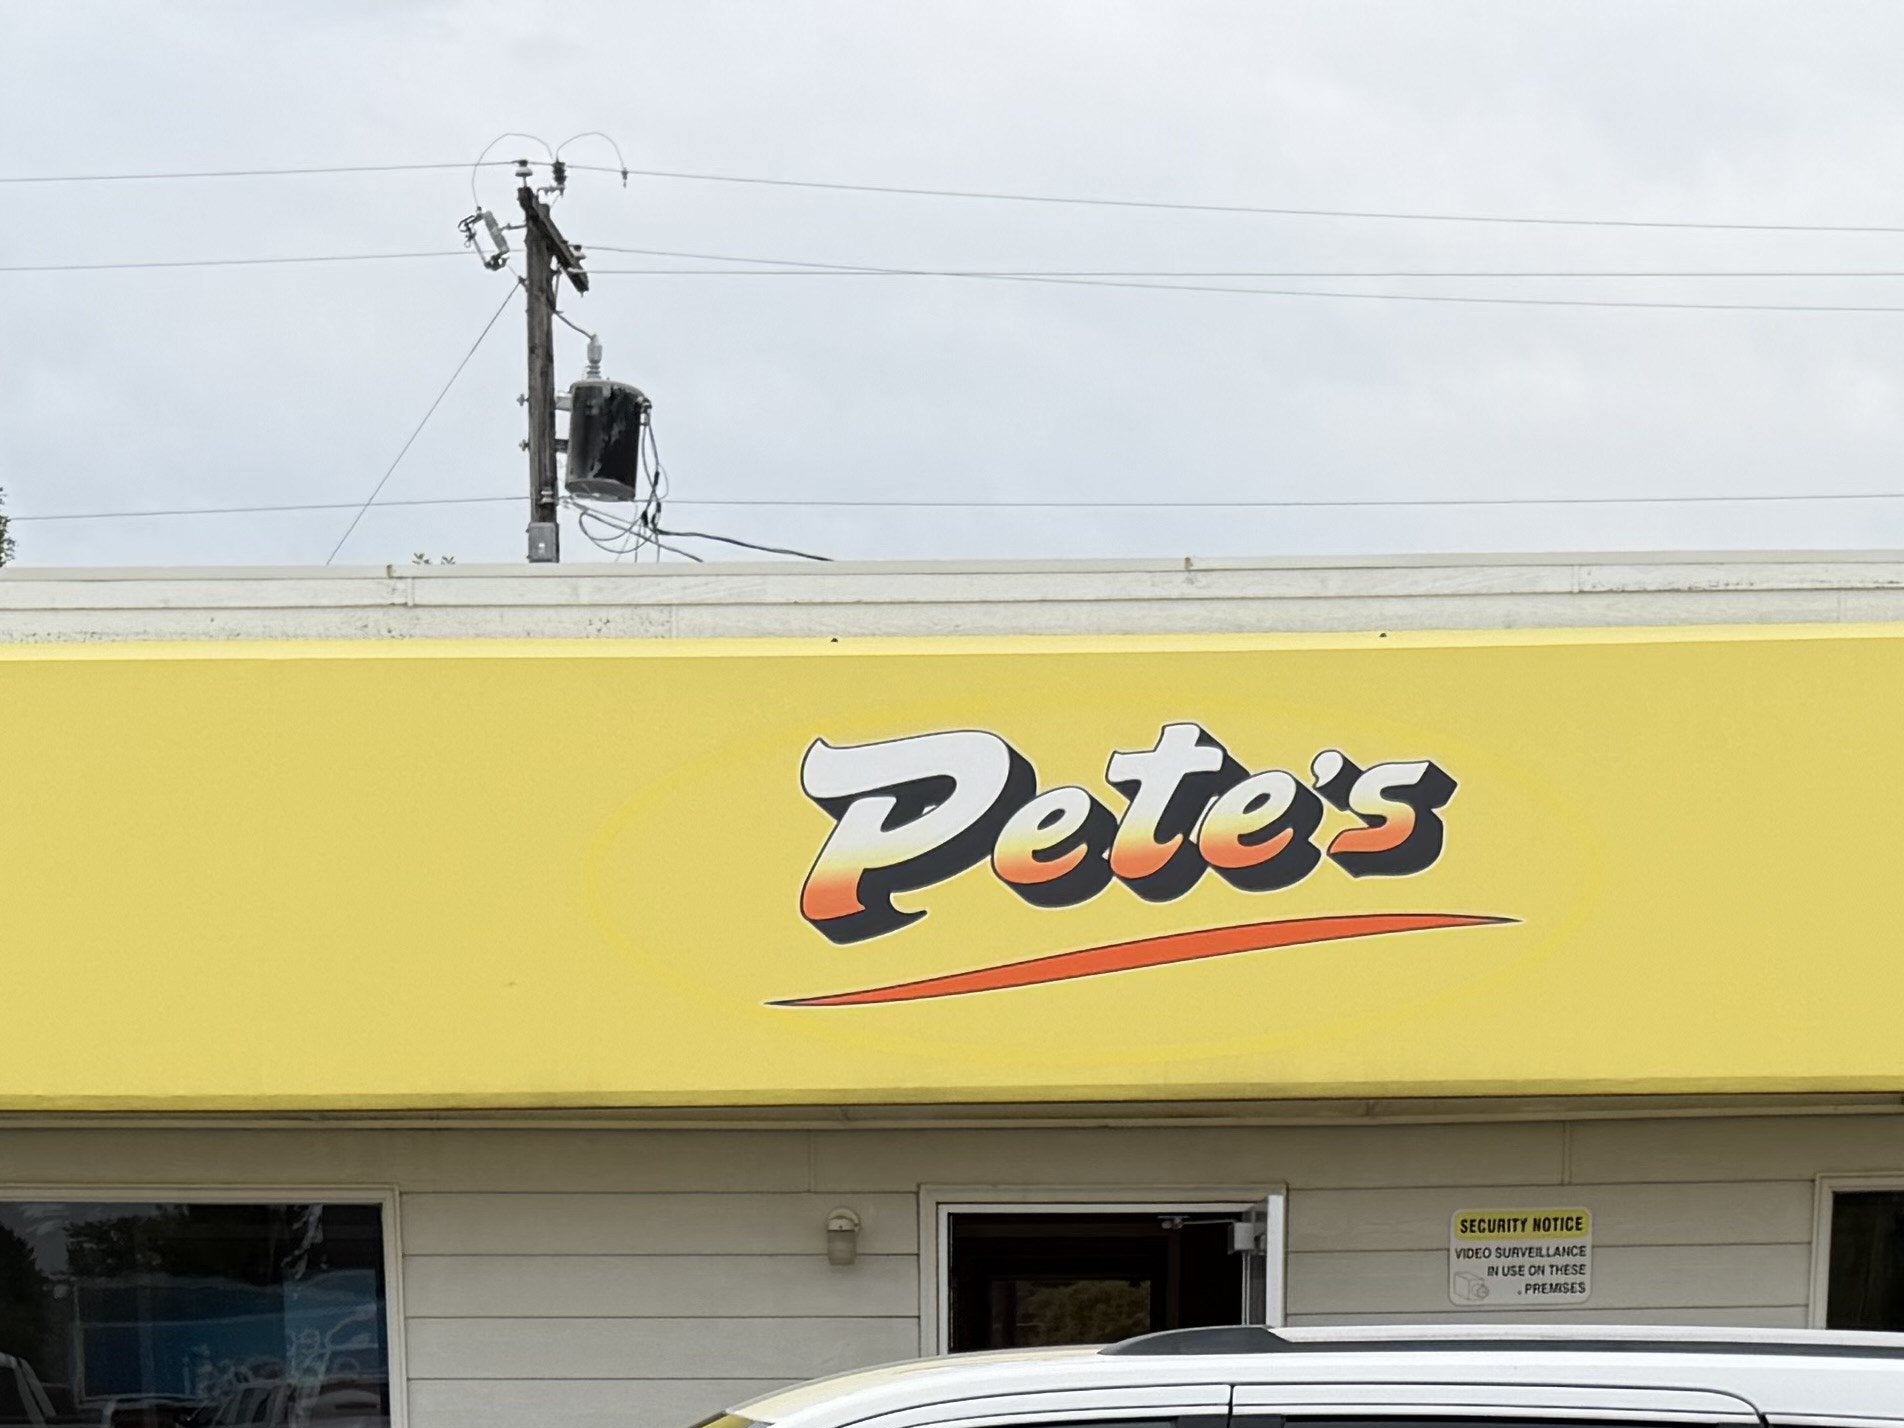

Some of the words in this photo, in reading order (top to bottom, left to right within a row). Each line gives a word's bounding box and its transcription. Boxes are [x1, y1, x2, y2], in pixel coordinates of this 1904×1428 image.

[799, 723, 1458, 944] Pete's
[1459, 1217, 1528, 1235] SECURITY
[1532, 1215, 1584, 1232] NOTICE
[1455, 1247, 1492, 1260] VIDEO
[1494, 1245, 1587, 1259] SURVEILLANCE
[1487, 1265, 1499, 1277] IN
[1502, 1264, 1525, 1277] USE
[1528, 1264, 1546, 1276] ON
[1549, 1263, 1587, 1276] THESE
[1524, 1281, 1587, 1295] PREMISES
